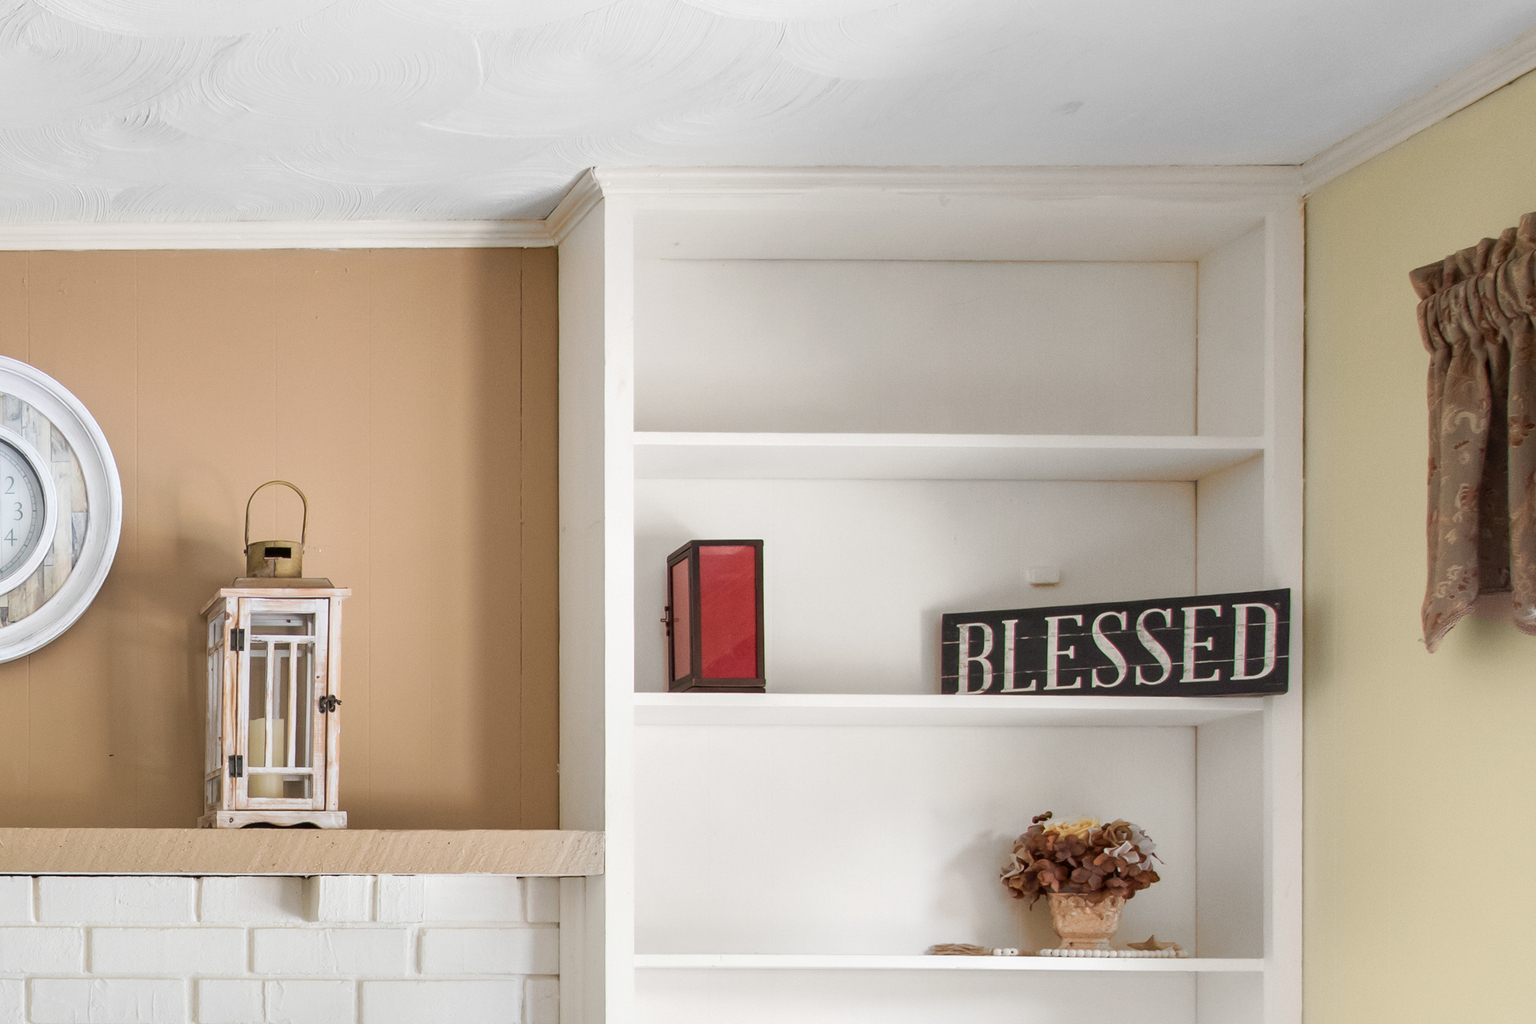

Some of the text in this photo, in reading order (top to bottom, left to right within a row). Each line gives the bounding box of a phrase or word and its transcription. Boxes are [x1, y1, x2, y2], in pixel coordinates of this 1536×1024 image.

[4, 476, 15, 495] 2
[13, 502, 24, 521] 3
[4, 528, 18, 547] 4
[955, 602, 1278, 695] BLESSED
